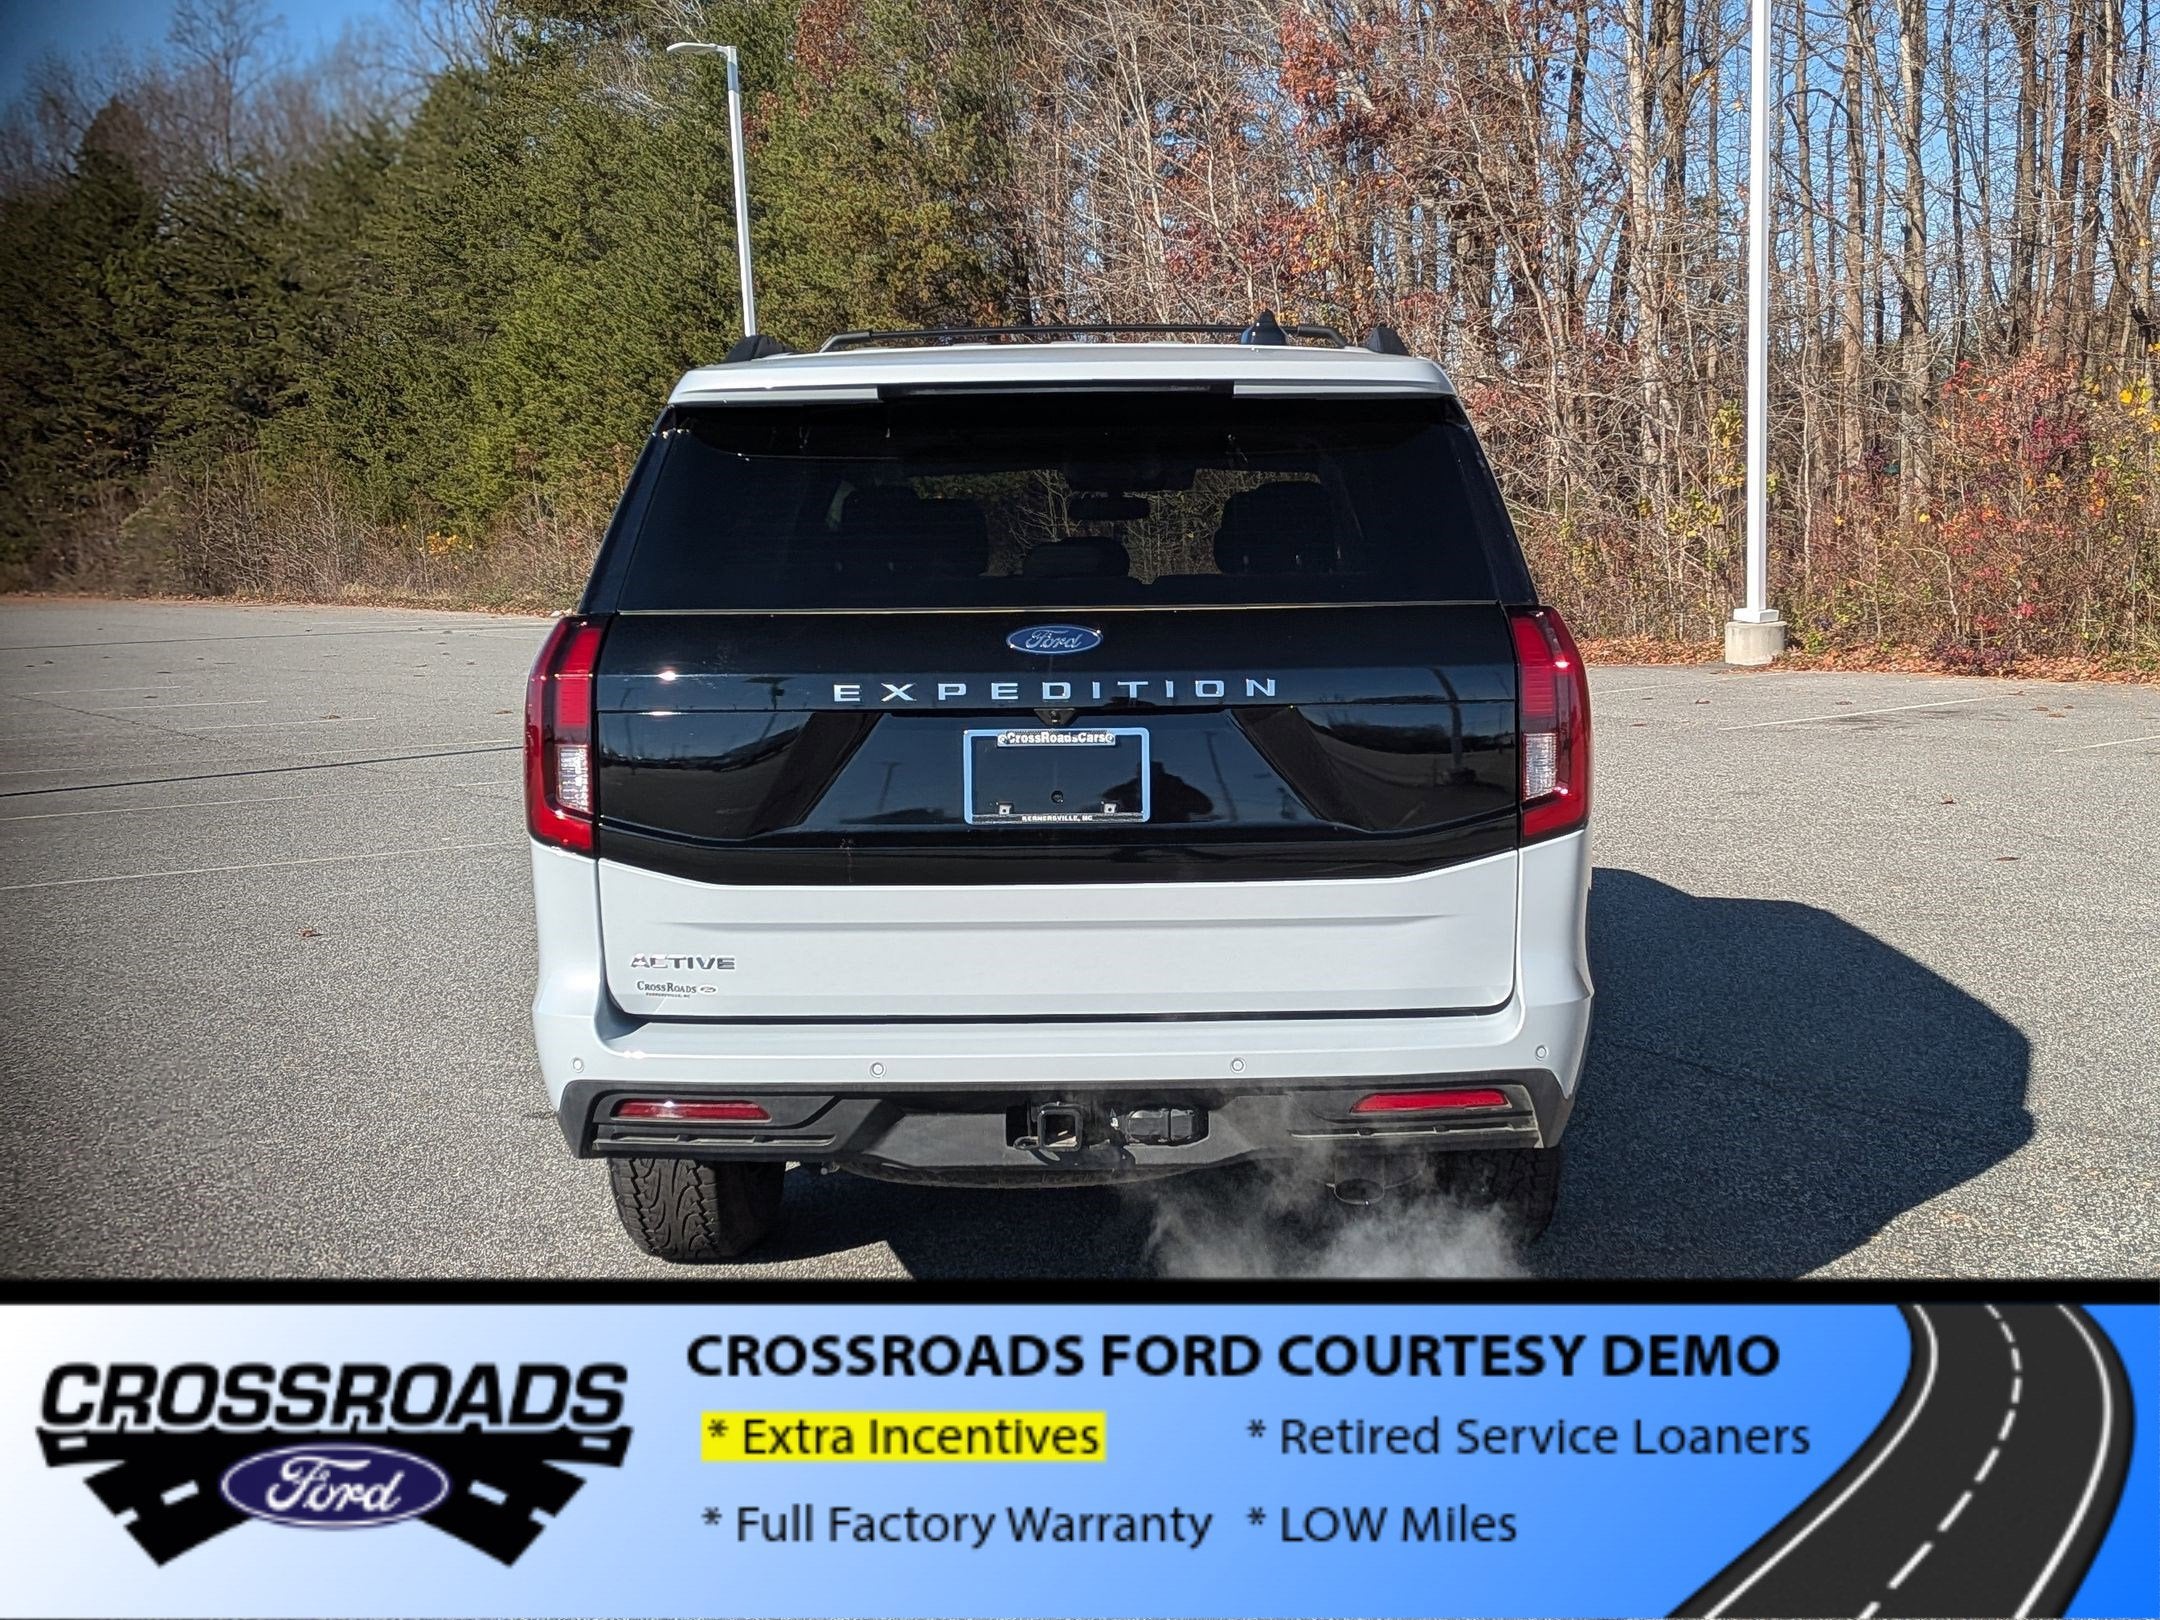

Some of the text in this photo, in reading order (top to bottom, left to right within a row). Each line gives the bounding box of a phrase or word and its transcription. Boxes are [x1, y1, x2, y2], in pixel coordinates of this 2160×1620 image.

[1025, 629, 1084, 649] Ford
[833, 678, 1277, 702] EXPEDITION
[631, 953, 736, 970] ACTIVE
